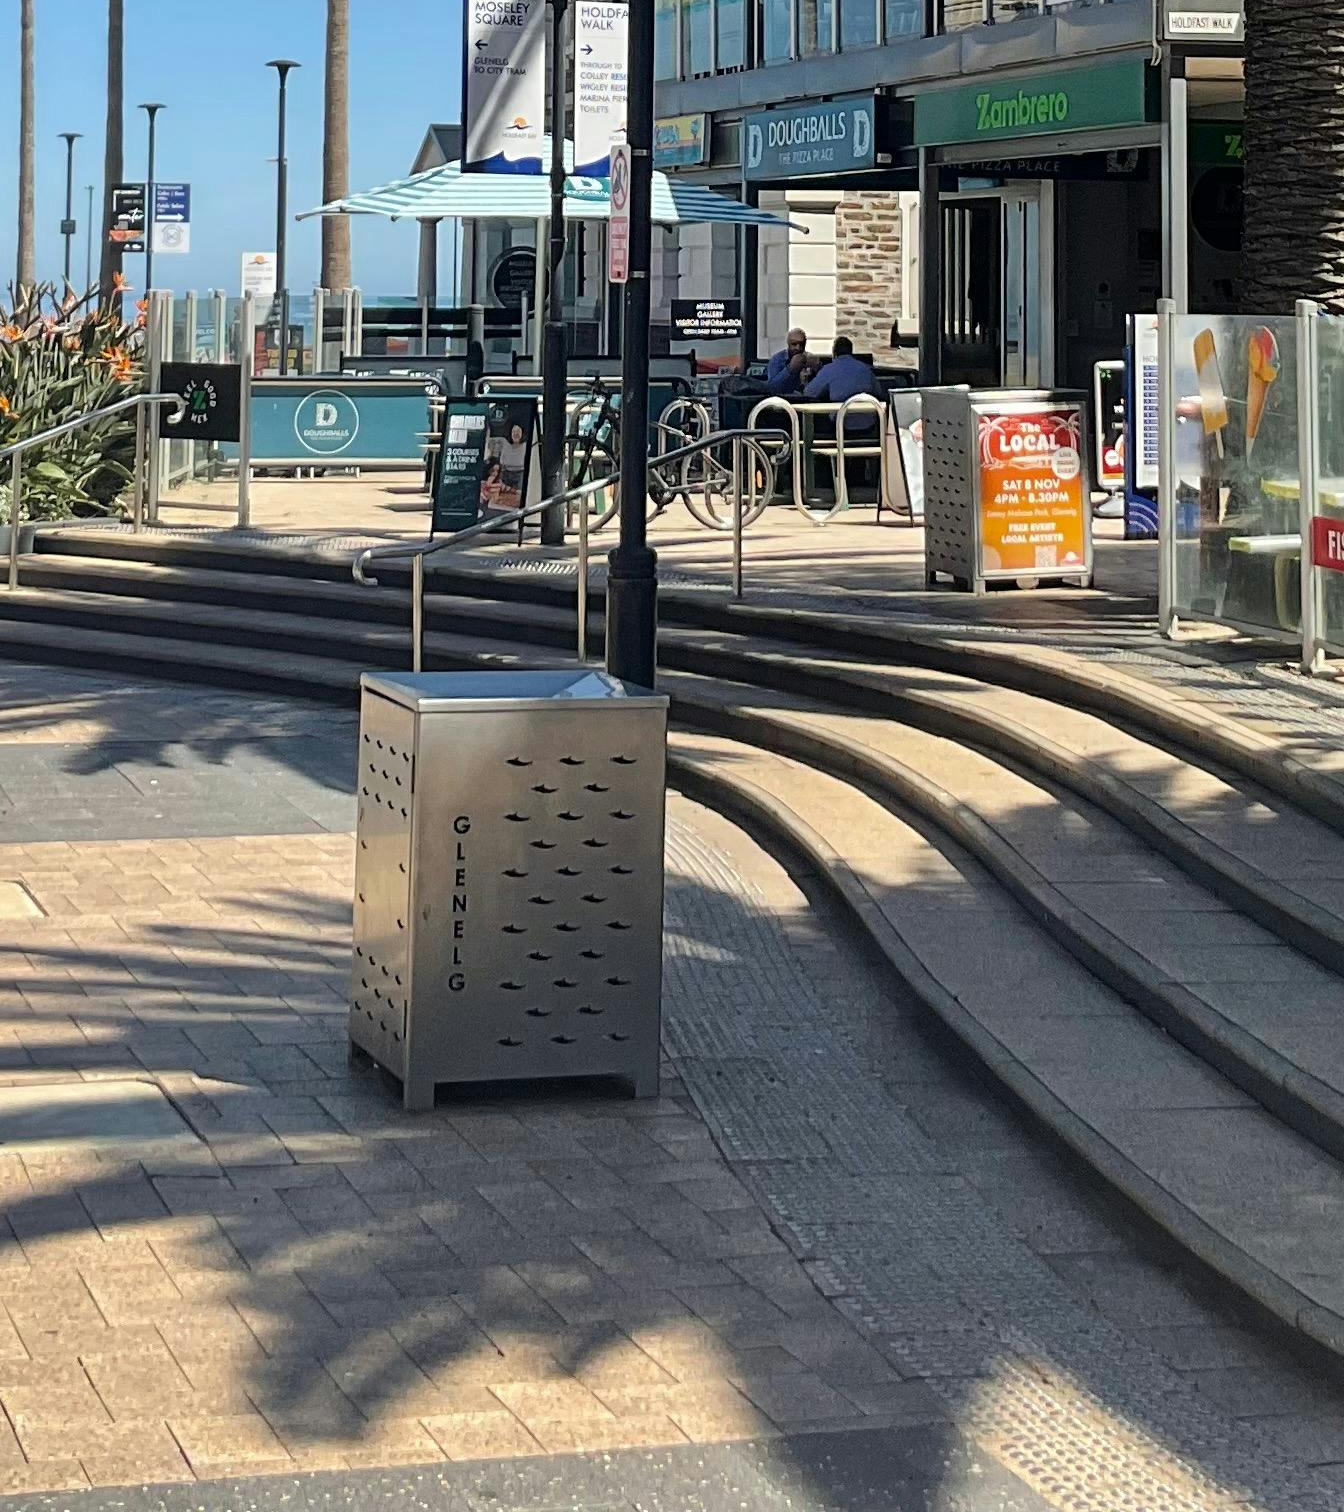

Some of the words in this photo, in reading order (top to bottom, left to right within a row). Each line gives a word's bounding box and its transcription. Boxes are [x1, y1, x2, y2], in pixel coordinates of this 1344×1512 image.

[475, 1, 530, 13] MOSELEY
[581, 6, 628, 19] HOLDFA
[475, 13, 524, 26] SQUARE
[581, 19, 614, 31] WALK
[1171, 16, 1210, 29] HOLDFAST
[1212, 17, 1233, 29] WALK
[474, 56, 509, 66] GLENELG
[581, 62, 613, 70] THROUGH
[486, 66, 503, 75] CITY
[505, 67, 526, 76] TRAM
[580, 72, 609, 80] COLLEY
[580, 84, 609, 92] WIGLEY
[580, 94, 610, 102] MARINA
[580, 104, 609, 113] TOILETS
[976, 90, 1068, 130] Zambrero
[768, 111, 846, 148] DOUGHBALLS
[779, 152, 791, 165] THE
[792, 150, 811, 163] PIZZA
[813, 148, 834, 162] PLACE
[972, 160, 1011, 172] PIZZA
[1017, 159, 1060, 172] PLACE
[697, 310, 723, 318] GALLERY
[316, 403, 338, 426] D
[1019, 422, 1041, 433] The
[999, 434, 1060, 453] LOCAL
[1002, 479, 1022, 491] SAT
[1024, 479, 1032, 490] 8
[1034, 478, 1060, 490] NOV
[994, 493, 1019, 504] 4PM
[1028, 491, 1069, 503] 8.30PM
[1030, 522, 1056, 531] EVENT
[1001, 534, 1027, 544] LOCAL
[448, 816, 471, 991] GLENELG
